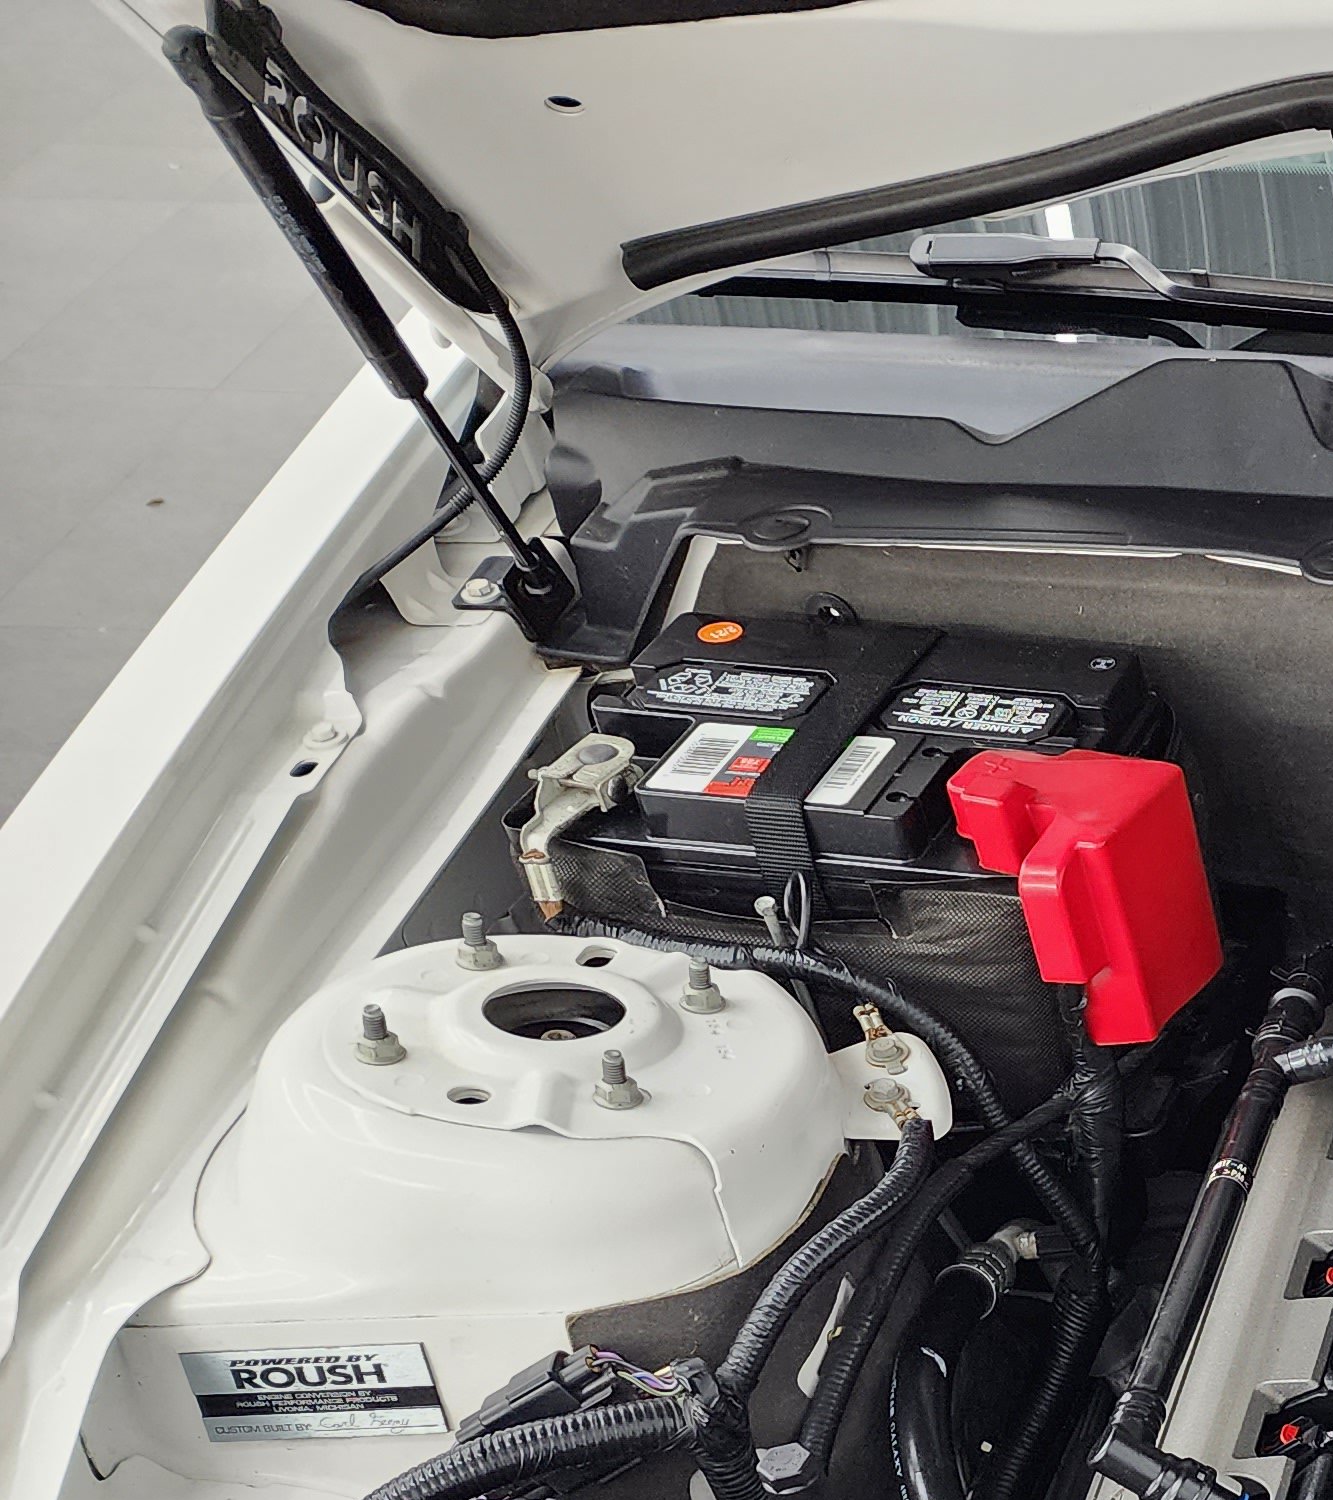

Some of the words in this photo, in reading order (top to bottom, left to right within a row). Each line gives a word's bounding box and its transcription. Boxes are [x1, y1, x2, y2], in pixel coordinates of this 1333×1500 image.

[264, 56, 422, 264] ROUSH
[229, 1356, 341, 1367] POWERED
[346, 1354, 378, 1363] BY
[230, 1363, 387, 1390] ROUSH
[294, 1391, 357, 1399] CONVERSION
[236, 1400, 270, 1409] ROUSH
[272, 1398, 344, 1406] PERFORMANCE
[346, 1395, 398, 1404] PRODUCTS
[316, 1404, 365, 1412] MICHIGAN
[215, 1424, 260, 1435] CUSTOM
[264, 1423, 293, 1433] BUILT
[888, 1422, 904, 1478] GALAXY
